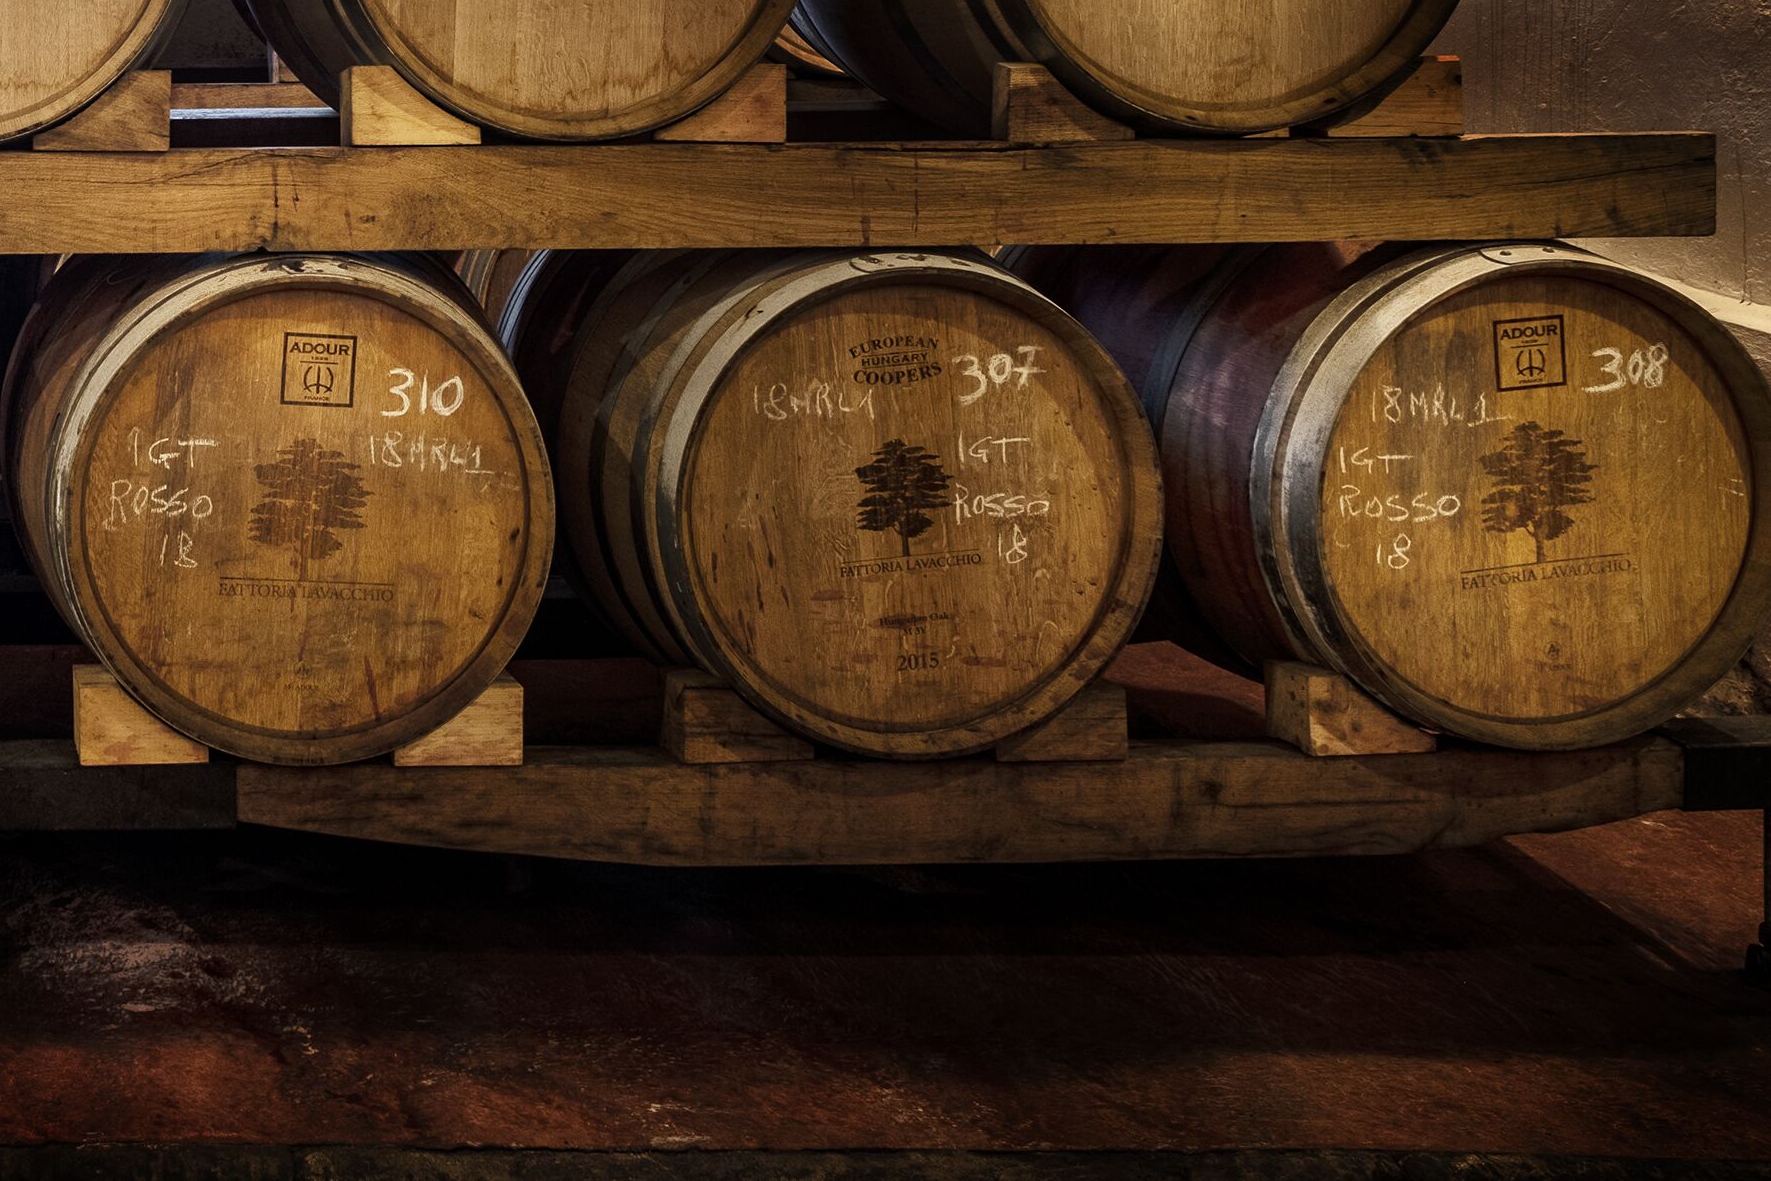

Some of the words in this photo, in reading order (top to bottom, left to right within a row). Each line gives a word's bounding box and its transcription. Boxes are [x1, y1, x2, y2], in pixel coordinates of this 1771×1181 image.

[849, 335, 940, 359] EUROPEAN
[1500, 324, 1558, 340] ADOUR
[289, 342, 350, 356] ADOUR
[861, 353, 928, 366] HUNGARY
[853, 361, 942, 385] COOPERS
[952, 345, 1047, 406] 307
[1581, 342, 1669, 393] 308
[380, 367, 464, 417] 310
[105, 478, 213, 530] ROSSO
[953, 483, 1050, 525] ROSSO
[1340, 485, 1461, 524] ROSSO
[998, 524, 1028, 564] 18
[1377, 533, 1411, 569] 18
[840, 561, 903, 577] FATTORIA
[906, 553, 982, 570] LAVACCHIO
[219, 582, 297, 598] FATTORIA
[302, 586, 394, 602] LAVACCHIO
[898, 652, 939, 671] 2015
